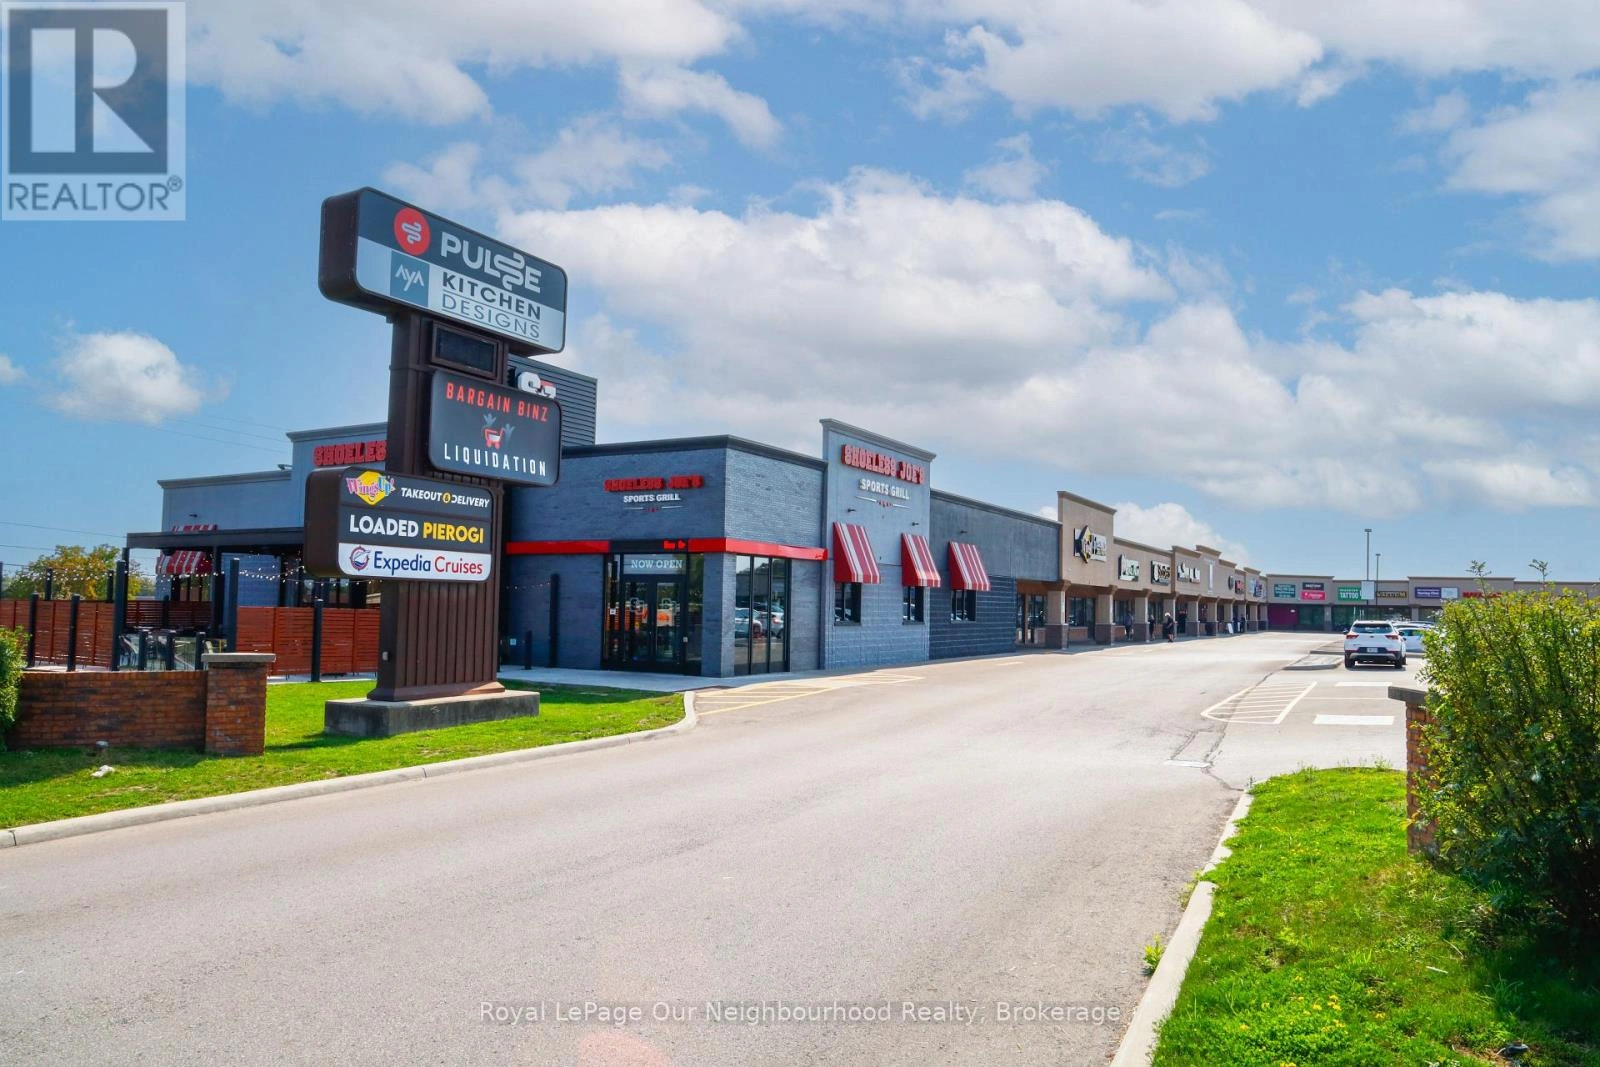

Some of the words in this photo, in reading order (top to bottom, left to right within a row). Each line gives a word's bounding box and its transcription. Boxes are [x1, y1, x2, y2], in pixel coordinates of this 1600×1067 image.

[440, 232, 541, 293] PULSE
[442, 272, 541, 320] KITCHEN
[442, 293, 540, 338] DESIGNS
[446, 382, 511, 413] BARGAIN
[517, 399, 548, 422] BINZ
[313, 440, 387, 467] SHOELES
[444, 442, 546, 477] LIQUIDATION
[401, 487, 442, 502] TAKEOUT
[451, 495, 490, 508] DELIVERY
[623, 494, 655, 503] SPORTS
[656, 493, 681, 502] GRILL
[860, 478, 889, 495] SPORTS
[890, 486, 910, 500] GRILL
[350, 514, 419, 537] LOADED
[422, 522, 484, 544] PIEROGI
[374, 551, 431, 575] Expedia
[434, 556, 483, 575] Cruises
[631, 560, 654, 569] NOW
[656, 560, 683, 569] OPEN
